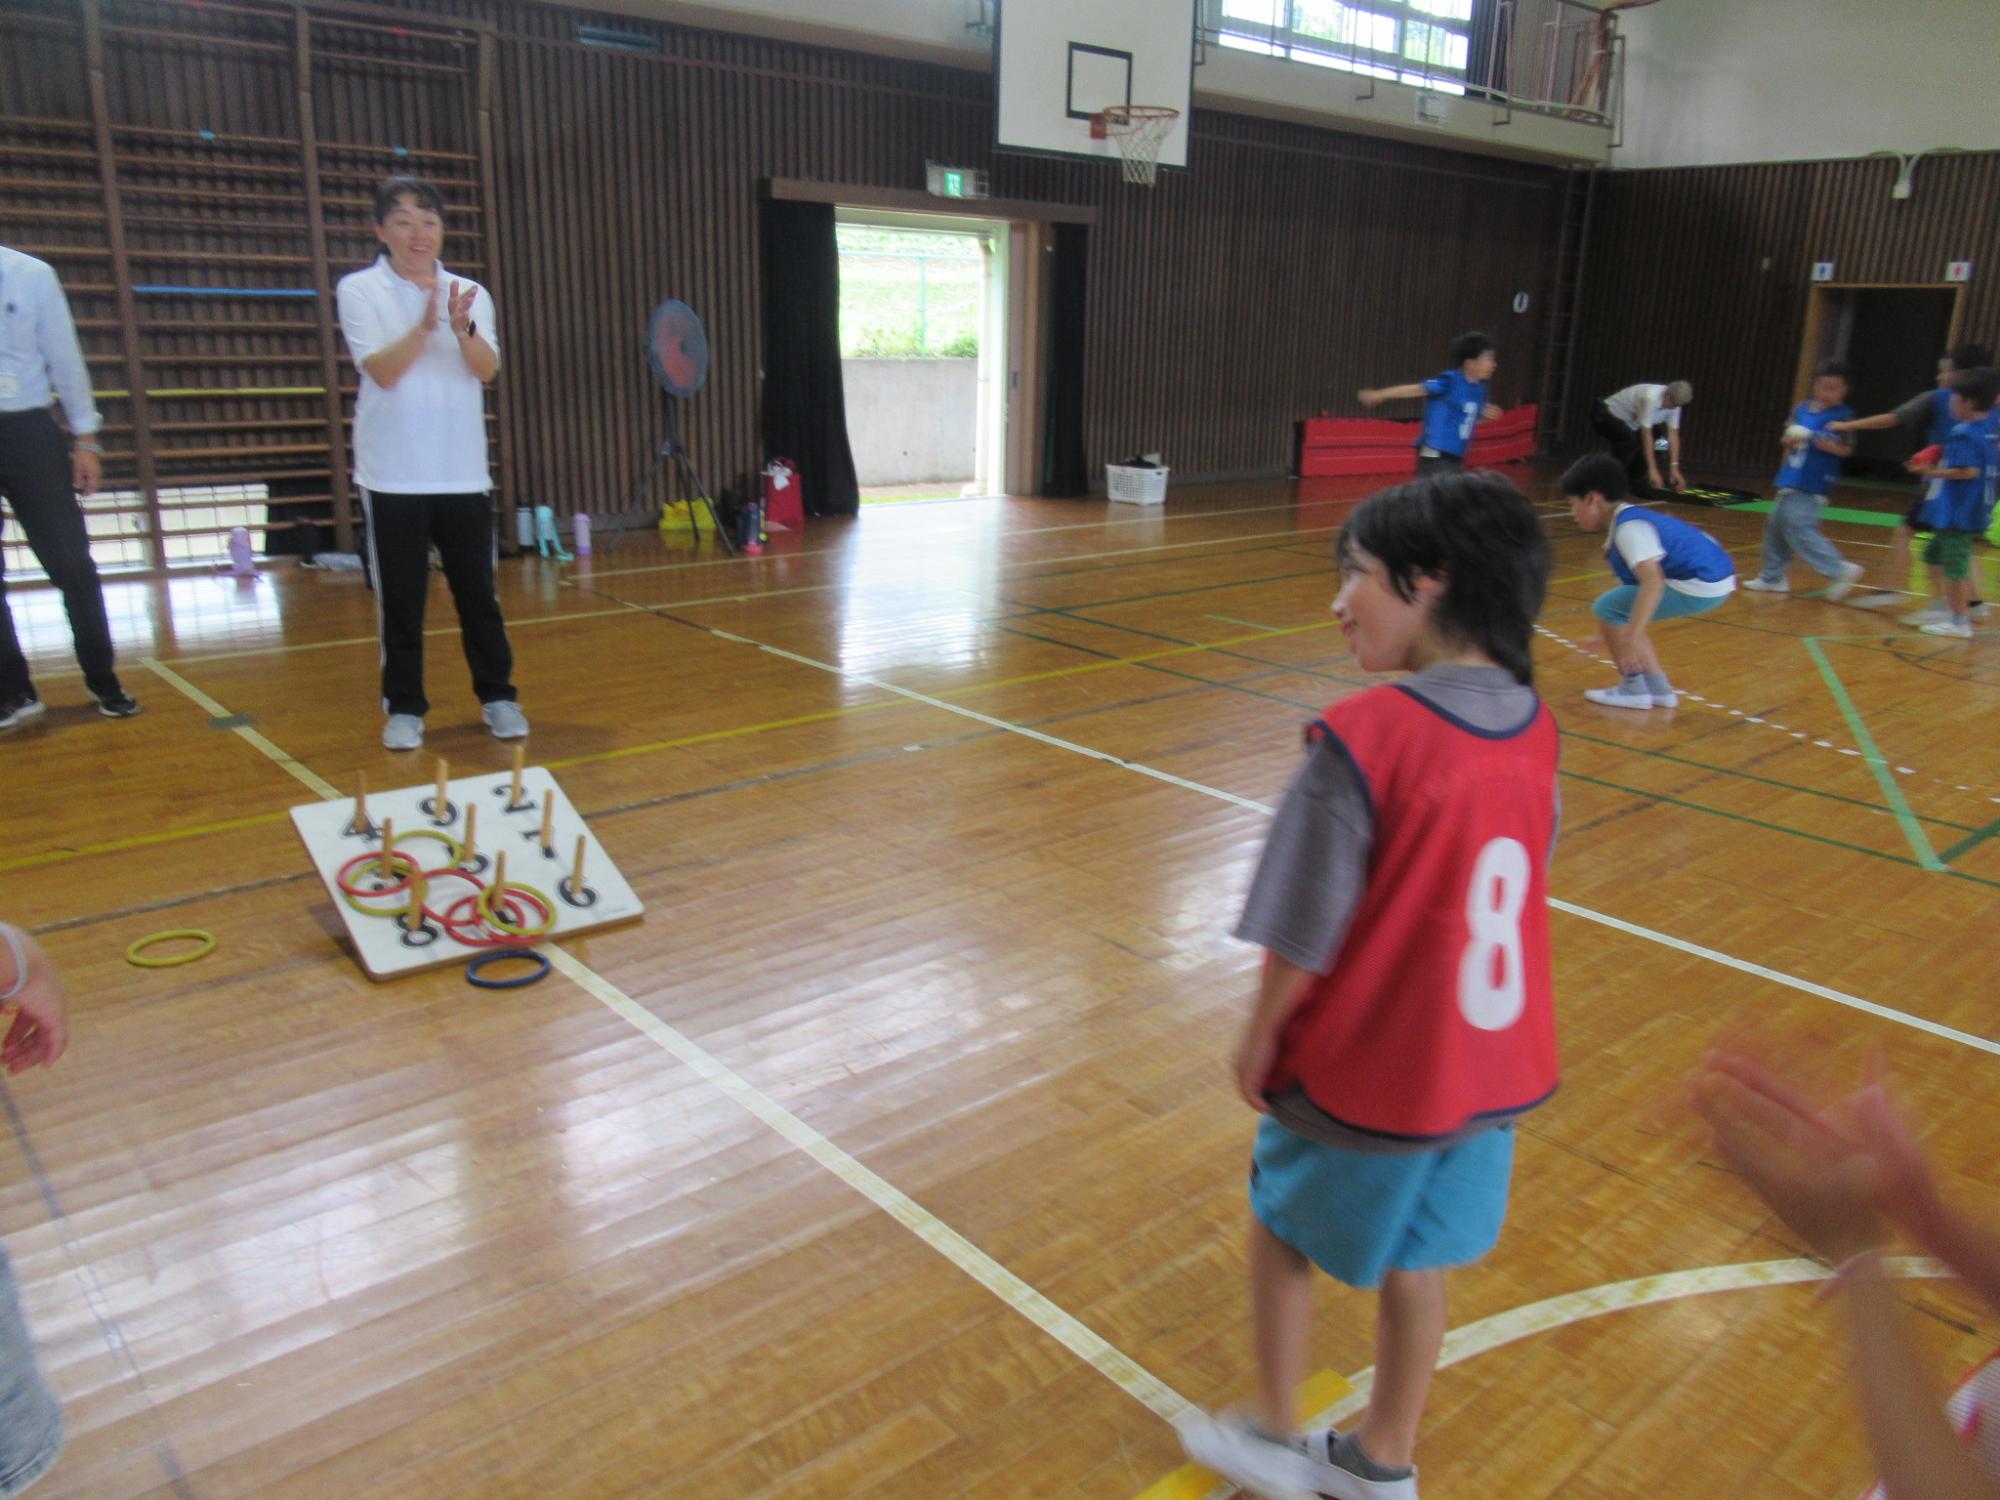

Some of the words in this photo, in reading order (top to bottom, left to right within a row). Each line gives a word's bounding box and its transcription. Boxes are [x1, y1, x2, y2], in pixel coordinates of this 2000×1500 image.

[419, 798, 458, 827] 9
[493, 785, 536, 813] 2
[557, 876, 597, 908] 6
[1457, 836, 1532, 1031] 8
